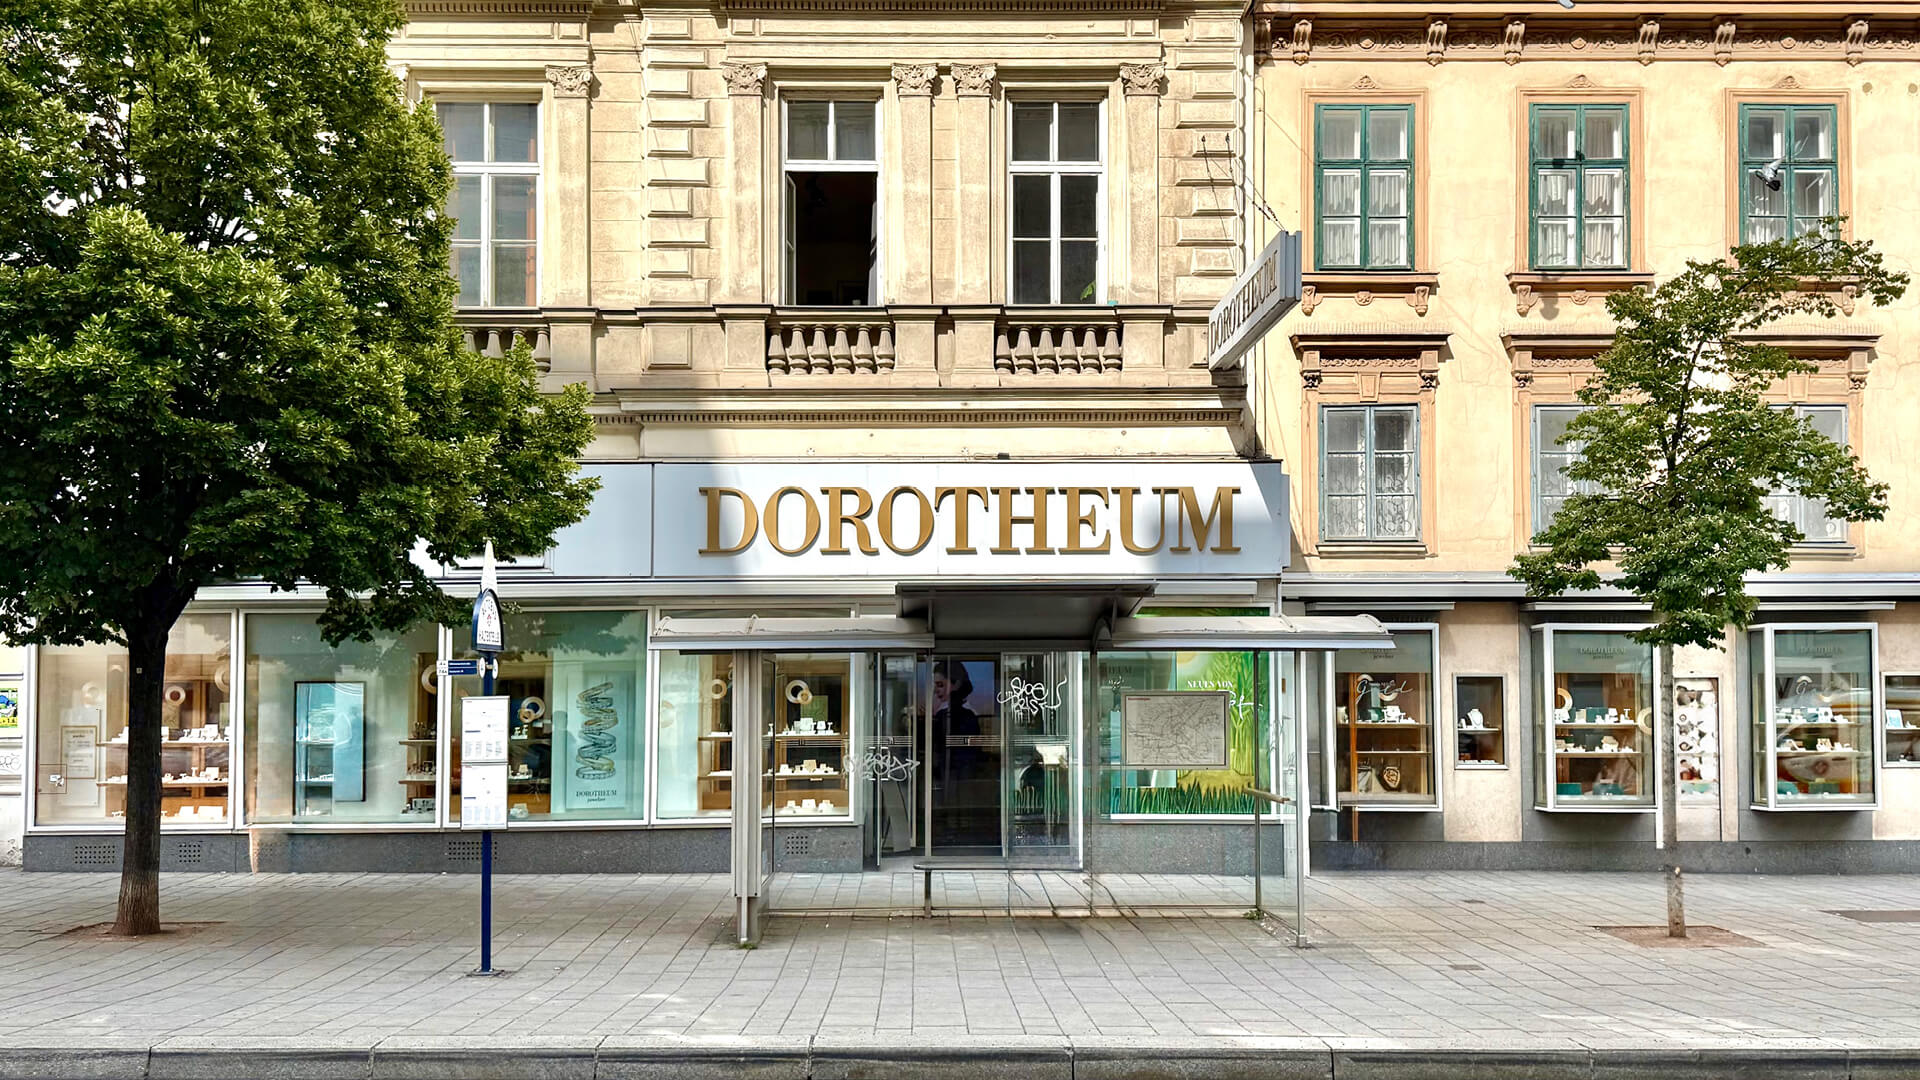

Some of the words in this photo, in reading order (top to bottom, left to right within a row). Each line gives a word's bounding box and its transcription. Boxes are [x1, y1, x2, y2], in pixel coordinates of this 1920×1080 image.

[1209, 250, 1278, 356] DOROTHEUM
[698, 486, 1242, 555] DOROTHEUM
[575, 790, 617, 798] DOROTHEUM
